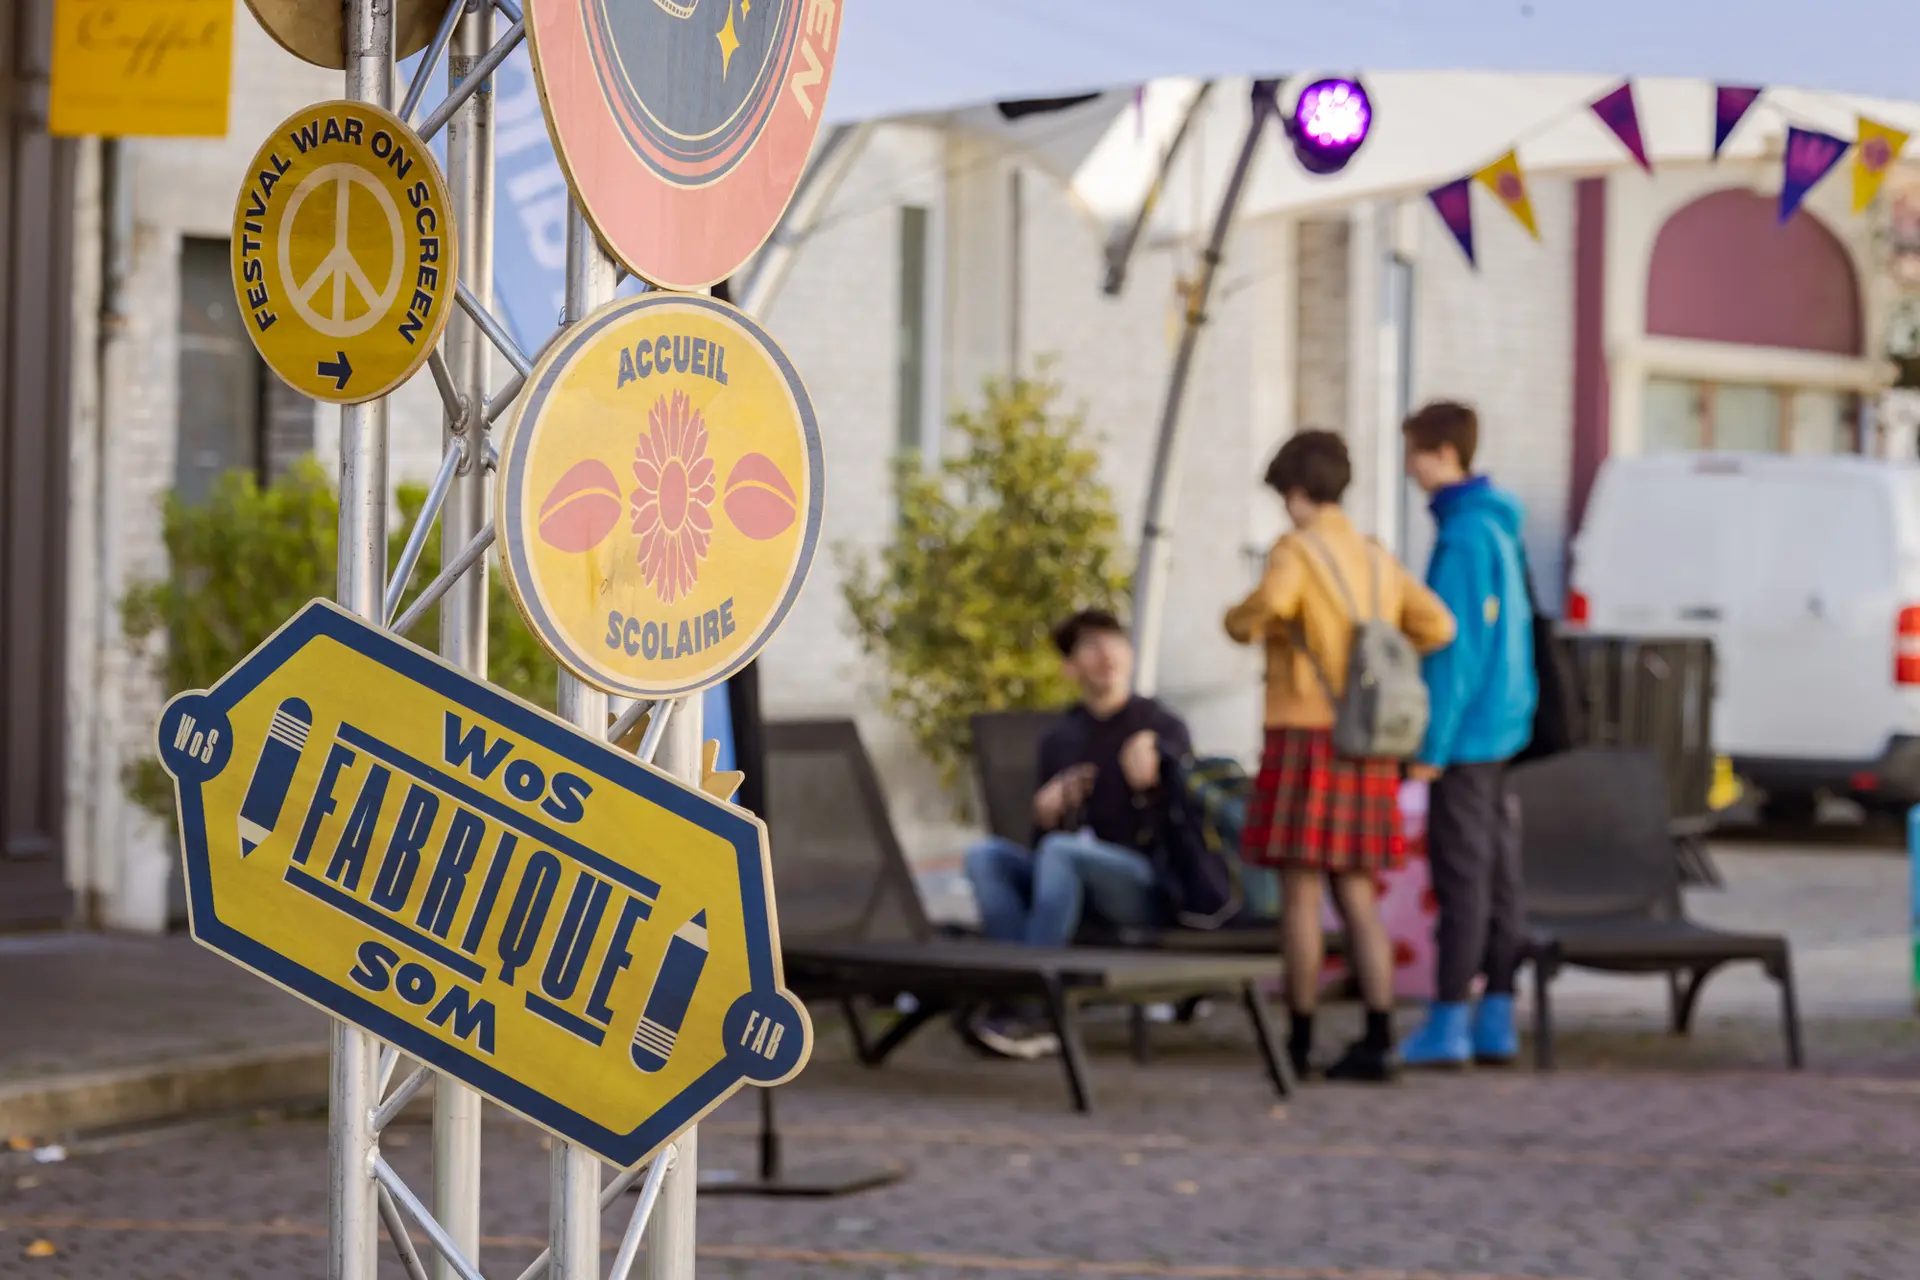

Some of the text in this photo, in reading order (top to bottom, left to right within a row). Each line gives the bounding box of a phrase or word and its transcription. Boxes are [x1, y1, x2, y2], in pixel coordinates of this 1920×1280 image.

[242, 152, 292, 333] FESTIVAL
[290, 116, 364, 154] WAR
[370, 130, 414, 181] ON
[398, 180, 440, 345] SCREEN
[617, 334, 729, 390] ACCUEIL
[604, 596, 736, 661] SCOLAIRE
[289, 742, 653, 1026] FABRIQUE
[740, 1009, 784, 1061] FAB
